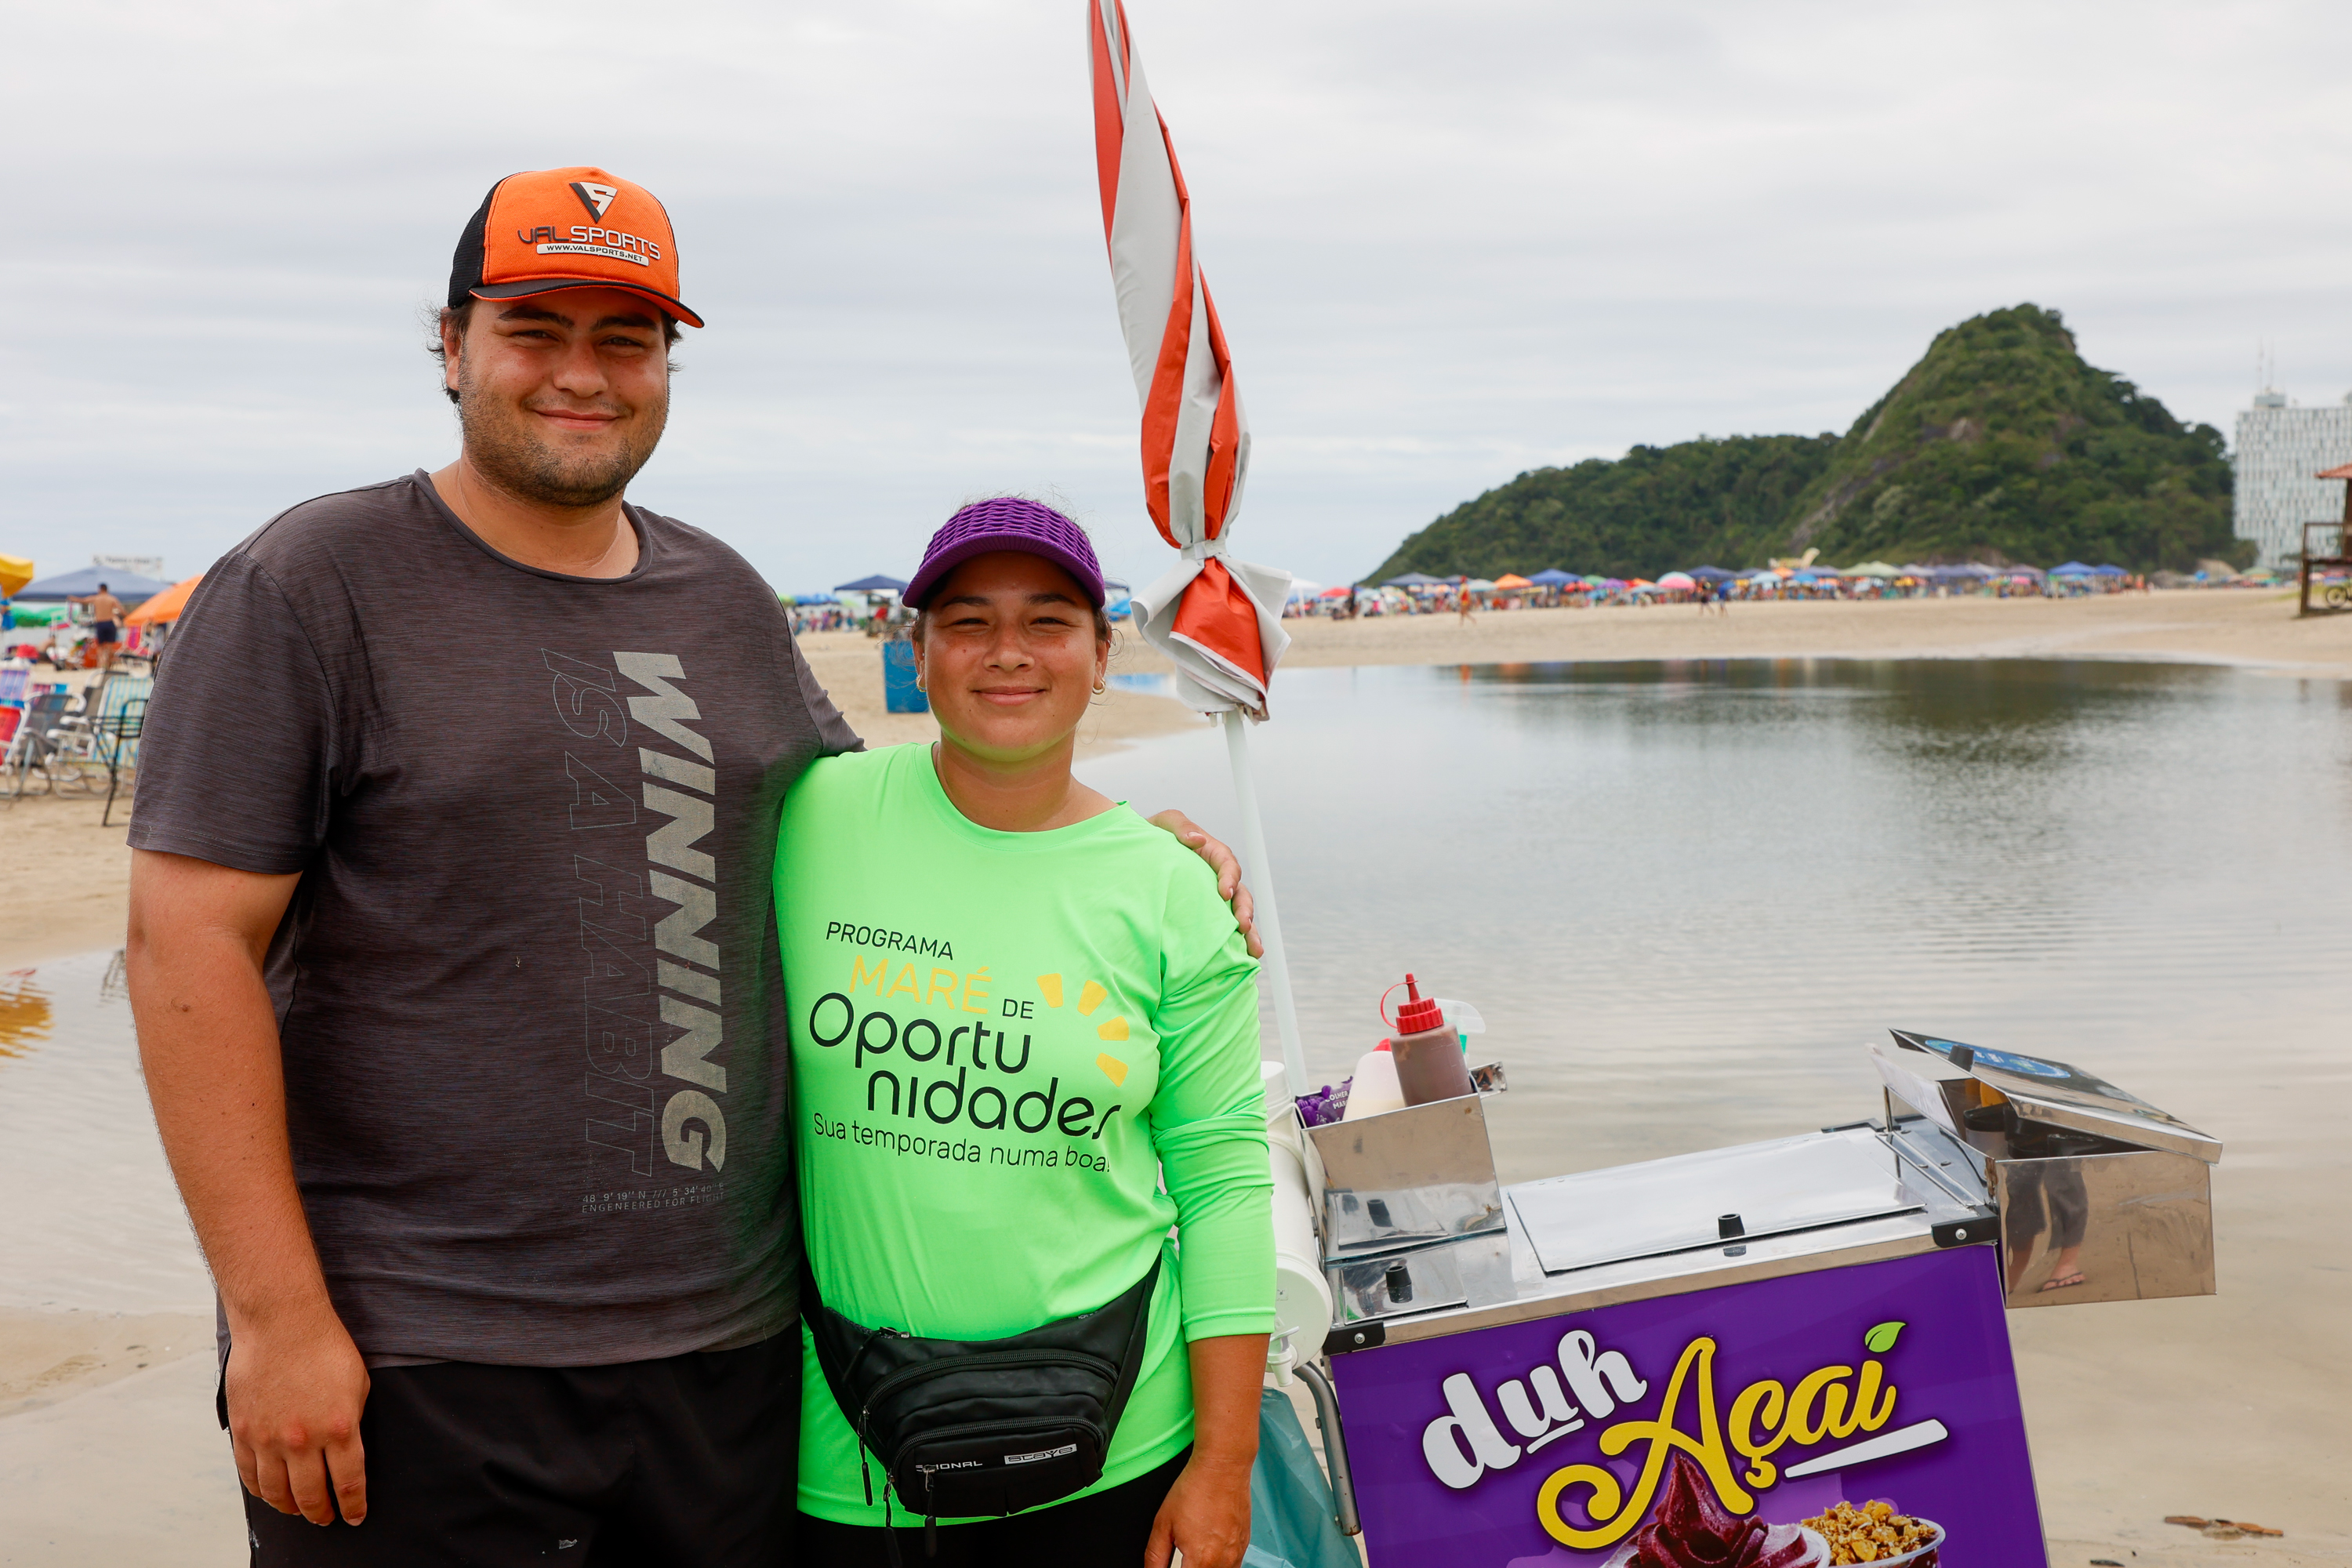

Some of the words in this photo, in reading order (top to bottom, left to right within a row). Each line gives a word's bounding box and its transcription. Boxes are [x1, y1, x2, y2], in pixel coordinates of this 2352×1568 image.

[546, 244, 643, 263] WWW.VALSPORTS.NET
[541, 648, 627, 747] IS
[565, 750, 637, 829] A
[613, 652, 727, 1173] WINNING
[826, 921, 953, 960] PROGRAMA
[575, 855, 655, 1177] HABIT
[848, 954, 993, 1014] MARÉ
[1002, 998, 1035, 1019] DE
[809, 992, 1031, 1074] Oportu
[867, 1066, 1122, 1139] nidades
[1325, 1091, 1348, 1102] OLHER
[814, 1112, 847, 1140] Sua
[851, 1123, 981, 1163] temporada
[989, 1146, 1058, 1167] numa
[582, 1200, 660, 1213] ENGENEERED
[666, 1198, 685, 1207] FOR
[690, 1192, 725, 1203] FLIGHT
[1423, 1330, 1647, 1489] duh
